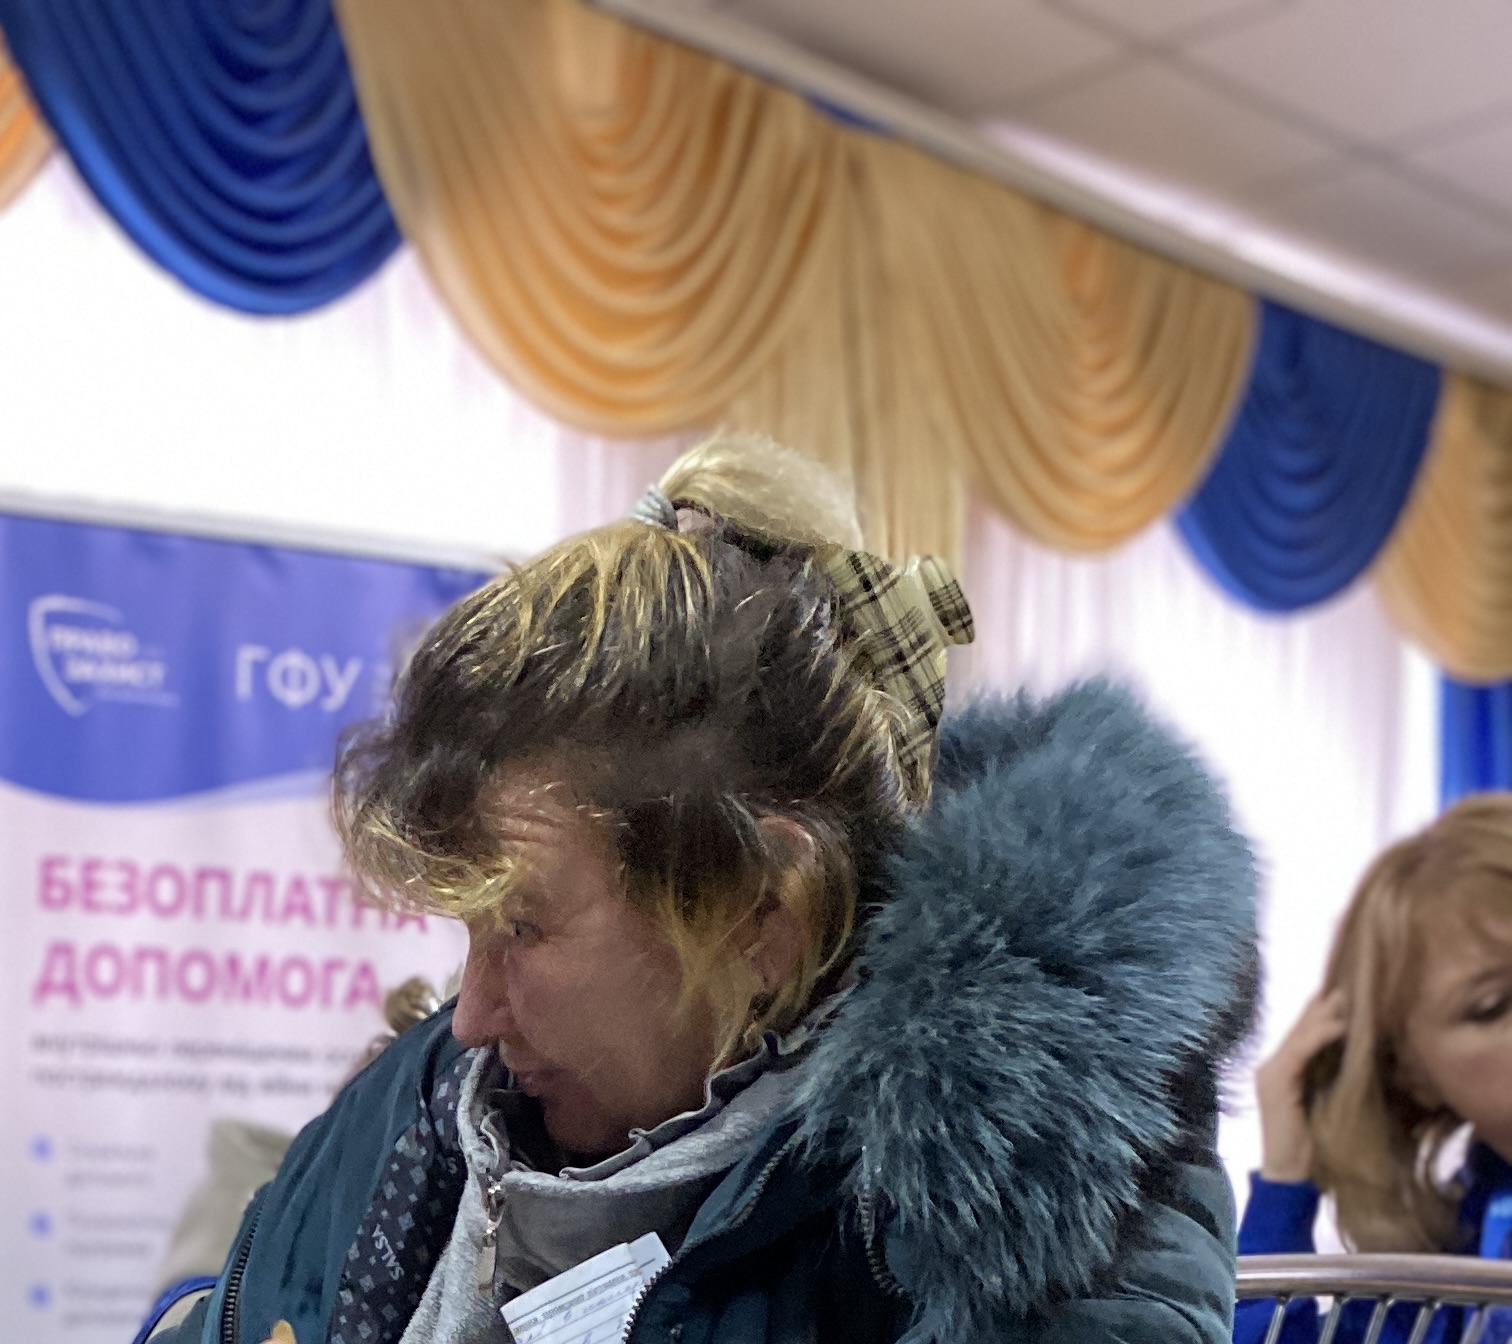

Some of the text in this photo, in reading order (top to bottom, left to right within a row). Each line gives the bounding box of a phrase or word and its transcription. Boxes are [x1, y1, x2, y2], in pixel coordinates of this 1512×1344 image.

[236, 645, 363, 712] ГФУ
[32, 940, 384, 1011] ДОПОМОГА
[371, 1223, 405, 1281] SALSA
